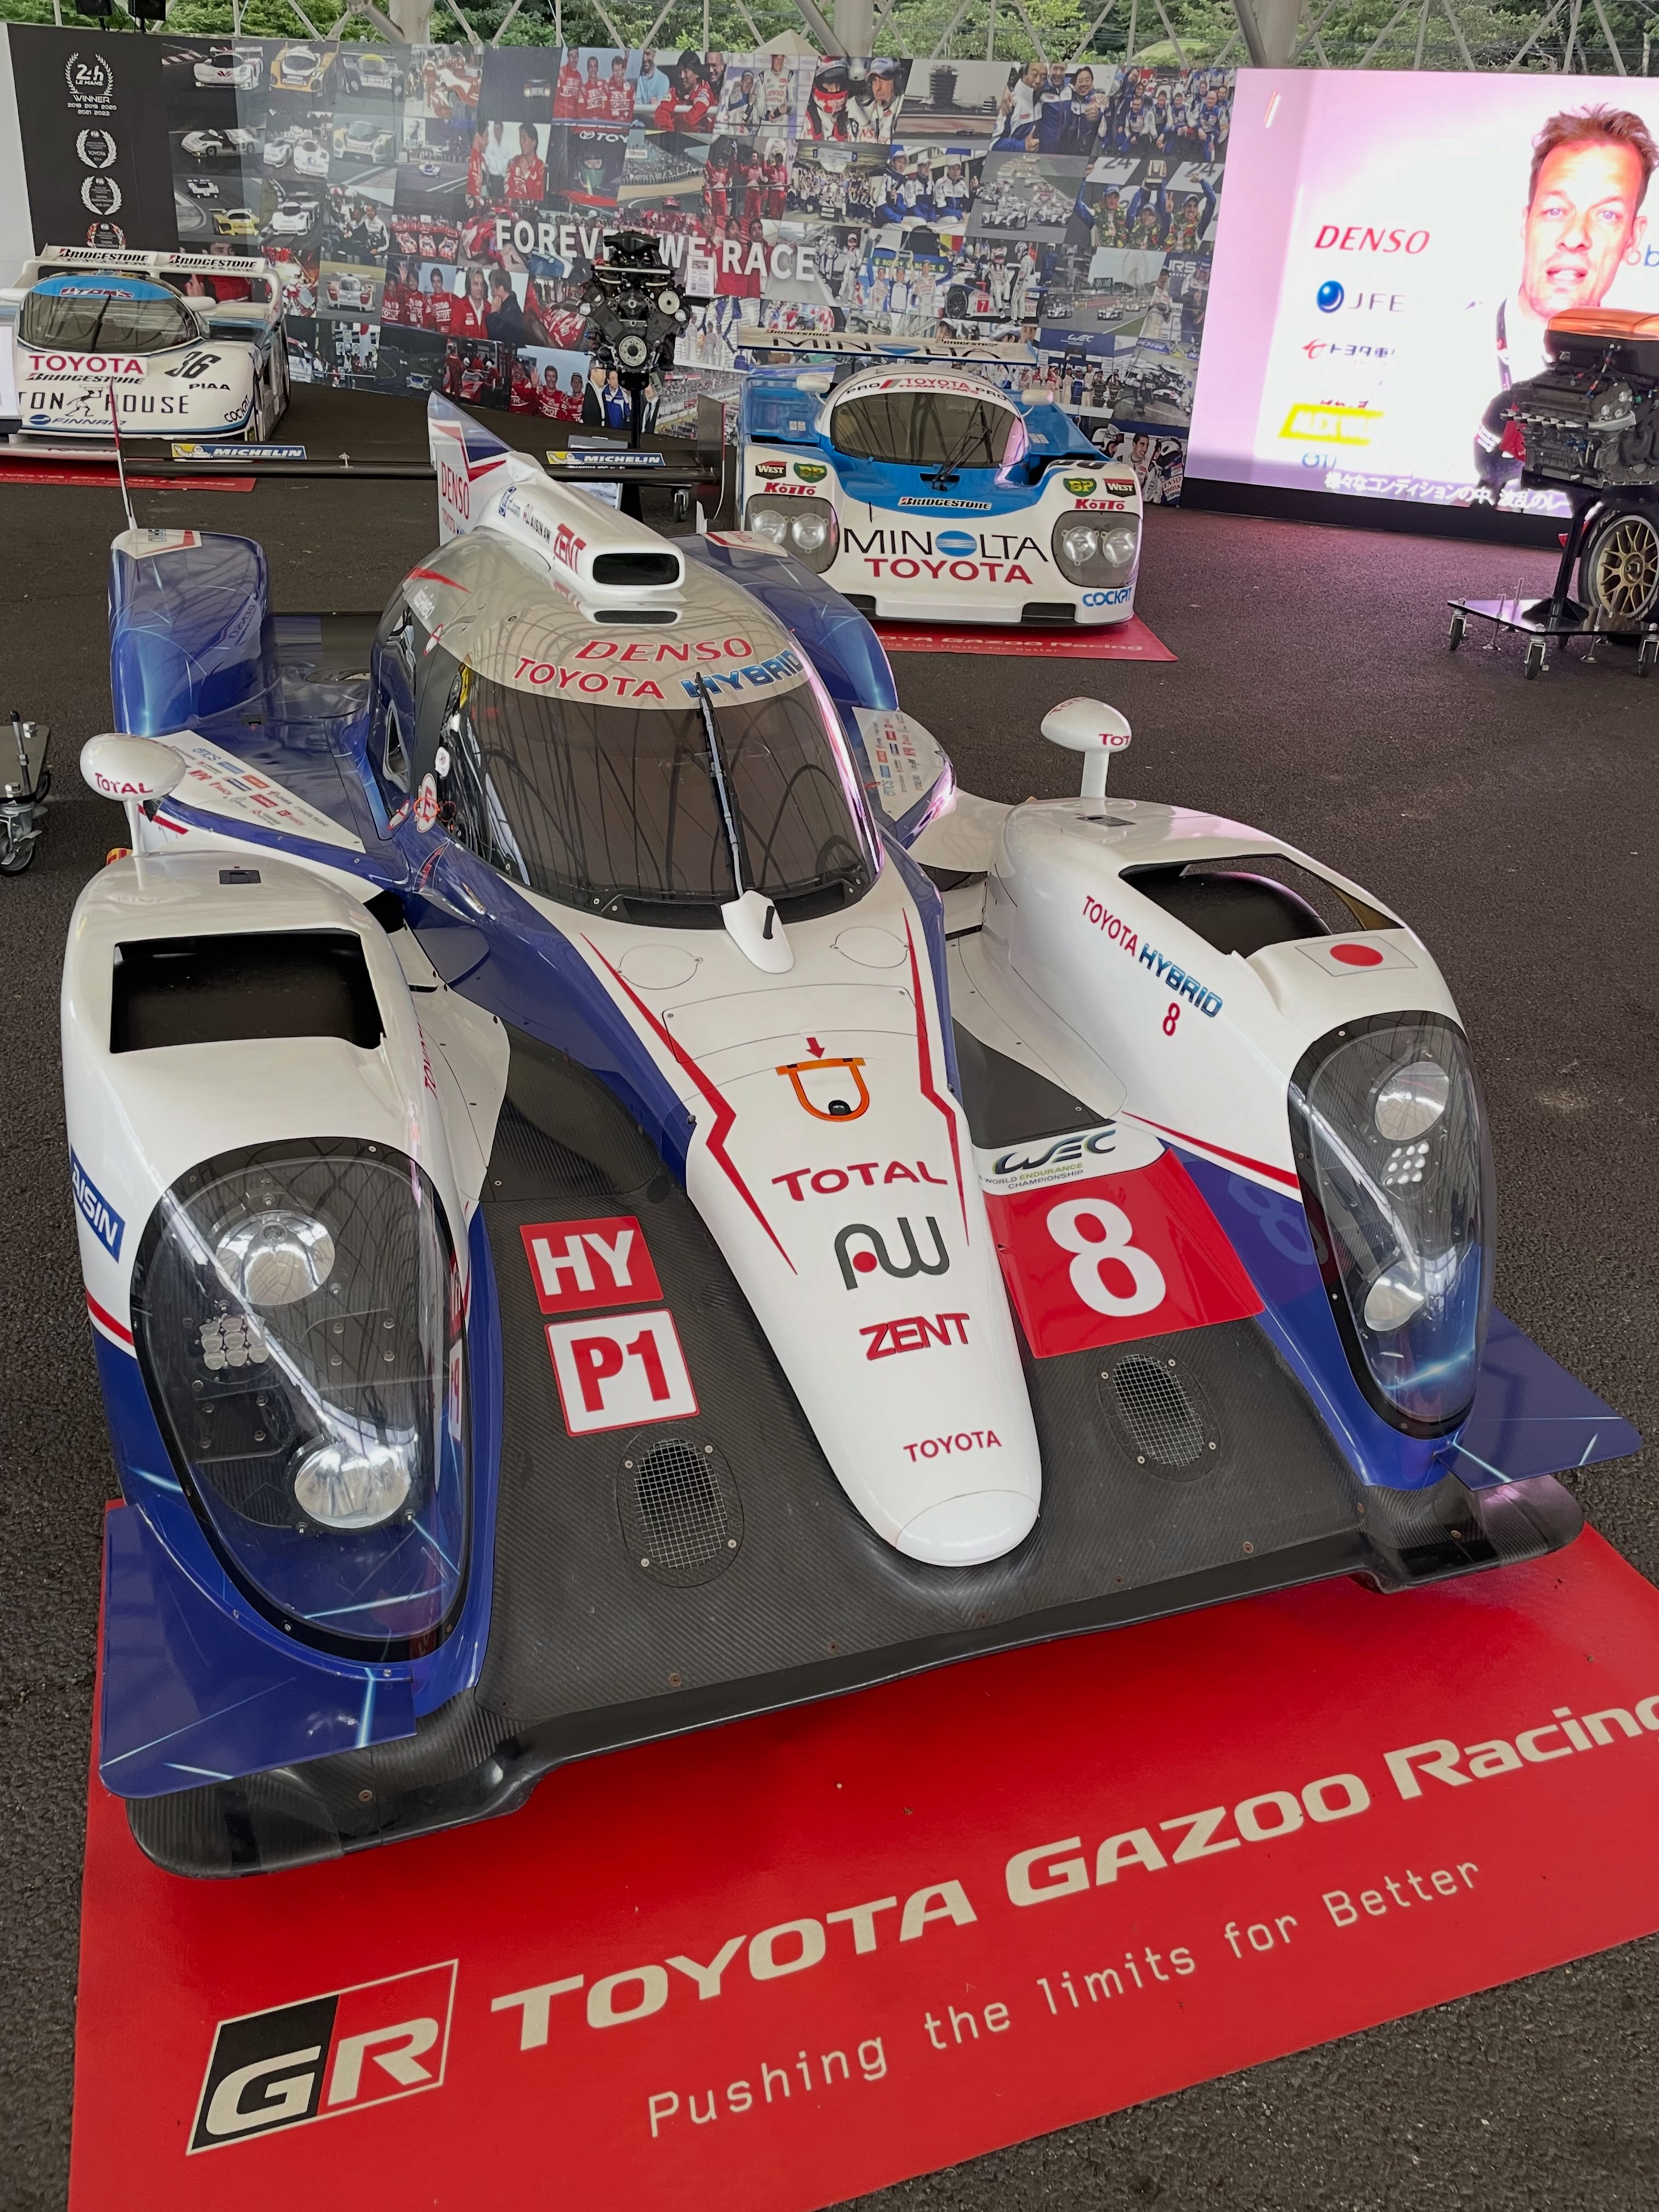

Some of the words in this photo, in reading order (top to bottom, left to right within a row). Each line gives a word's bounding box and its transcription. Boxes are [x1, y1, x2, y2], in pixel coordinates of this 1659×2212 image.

[72, 94, 110, 104] WINNER
[611, 91, 628, 99] ZENT
[496, 219, 610, 260] FOREV
[723, 240, 815, 281] RACE
[1314, 225, 1430, 254] DENSO
[58, 248, 149, 262] BRIDGESTONE
[167, 255, 257, 269] BRIDGESTONE
[980, 301, 987, 311] 7
[1347, 292, 1407, 312] JFE
[1067, 334, 1094, 343] WEC
[29, 354, 144, 375] TOYOTA
[165, 351, 222, 379] 36
[25, 373, 146, 385] BRIDGESTONE
[847, 383, 880, 394] PRO
[904, 377, 970, 389] TOYOTA
[105, 394, 189, 414] HOUSE
[975, 387, 1007, 401] PRO
[225, 394, 251, 422] COCKPIT
[213, 448, 302, 458] MICHELIN
[584, 455, 661, 464] MICHELIN
[757, 465, 785, 473] WEST
[798, 465, 825, 478] BP
[441, 461, 470, 520] DENSO
[1069, 480, 1094, 493] BP
[1107, 483, 1133, 492] WEST
[899, 497, 991, 510] BRIDGESTONE
[554, 523, 587, 574] ZENT
[864, 557, 1034, 585] TOYOTA
[1082, 586, 1132, 607] COCKPIT
[573, 637, 754, 662] DENSO
[941, 637, 1043, 646] GAZOO
[1051, 641, 1143, 651] Racing
[511, 656, 667, 700] TOYOTA
[680, 648, 805, 699] HYBRID
[94, 772, 153, 794] TOTAL
[1082, 895, 1138, 957] TOYOTA
[1138, 943, 1223, 1018] HYBRID
[1162, 1002, 1181, 1037] 8
[992, 1129, 1116, 1175] WEC
[771, 1160, 948, 1201] TOTAL
[984, 1176, 1017, 1184] WORLD
[1019, 1163, 1083, 1180] ENDURANCE
[1008, 1170, 1084, 1189] CHAMPIONSHIP
[71, 1165, 119, 1247] AISIN
[532, 1229, 635, 1296] HY
[1046, 1198, 1166, 1317] 8
[859, 1313, 970, 1361] ZENT
[570, 1330, 670, 1413] P1
[903, 1430, 1002, 1463] TOYOTA
[206, 2018, 438, 2135] GR
[491, 1880, 977, 2051] TOYOTA
[1006, 1774, 1370, 1906] GAZOO
[648, 2037, 887, 2137] Pushing
[925, 2001, 1010, 2049] the
[1037, 1943, 1195, 2014] limits
[1224, 1913, 1297, 1958] for
[1323, 1861, 1479, 1927] Better
